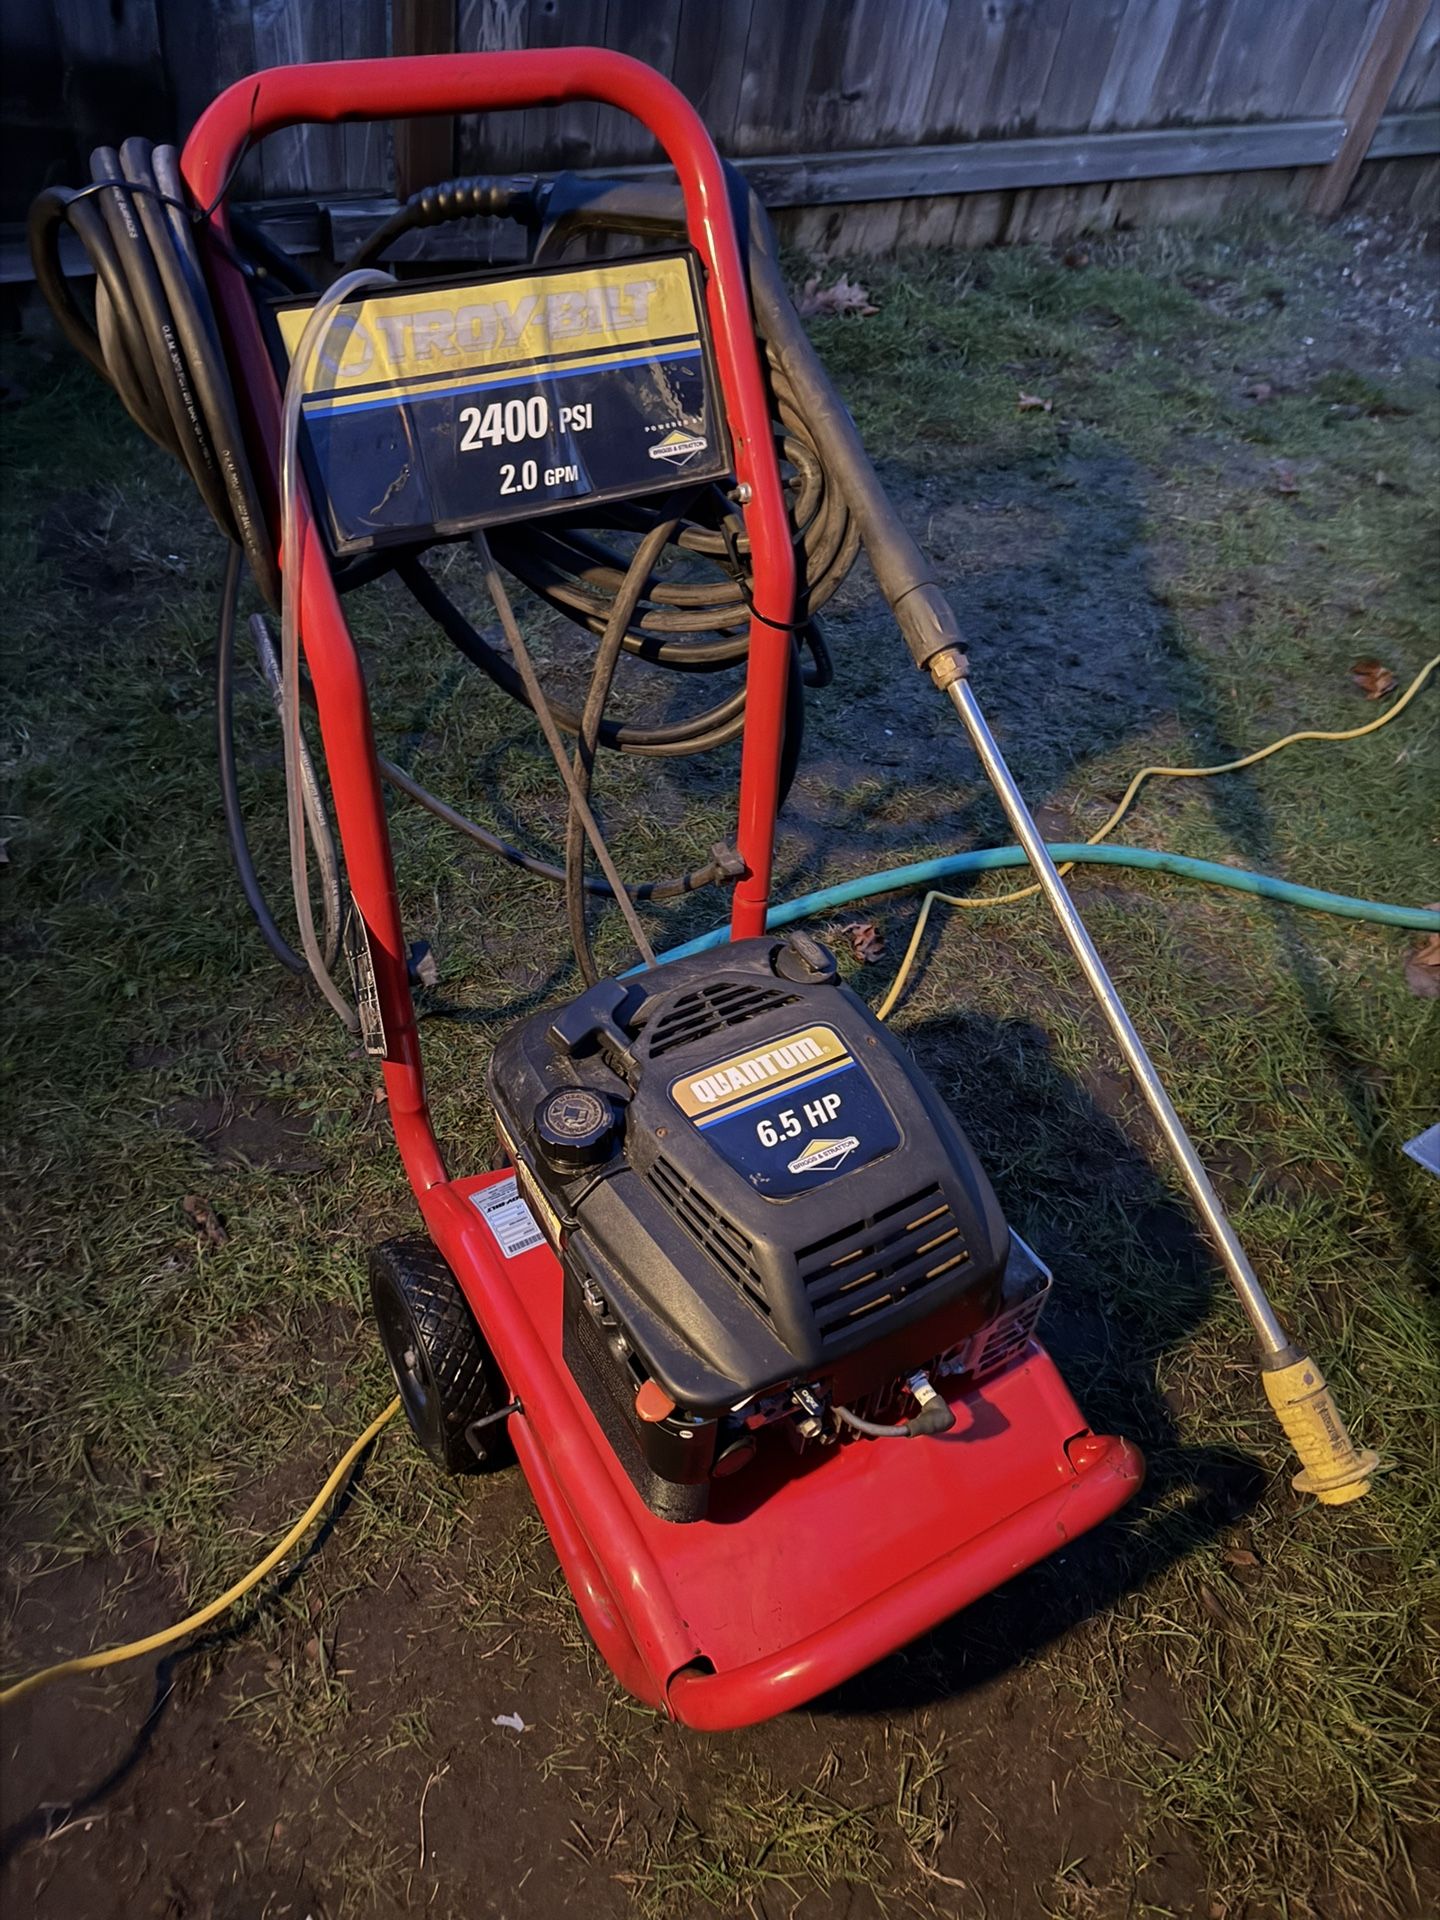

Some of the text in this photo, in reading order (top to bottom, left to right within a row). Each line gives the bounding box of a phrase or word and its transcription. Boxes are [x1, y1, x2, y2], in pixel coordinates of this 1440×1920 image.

[377, 279, 657, 364] TROY-BILT
[459, 396, 593, 452] 2400 PSI
[644, 419, 689, 432] POWERED
[678, 441, 704, 451] STRATTON
[499, 460, 579, 496] 2.0 GPM
[690, 1037, 824, 1104] QUANTUM
[756, 1093, 842, 1148] 6.5 HP
[793, 1155, 817, 1171] BRIGGS
[823, 1140, 855, 1157] STRATTON
